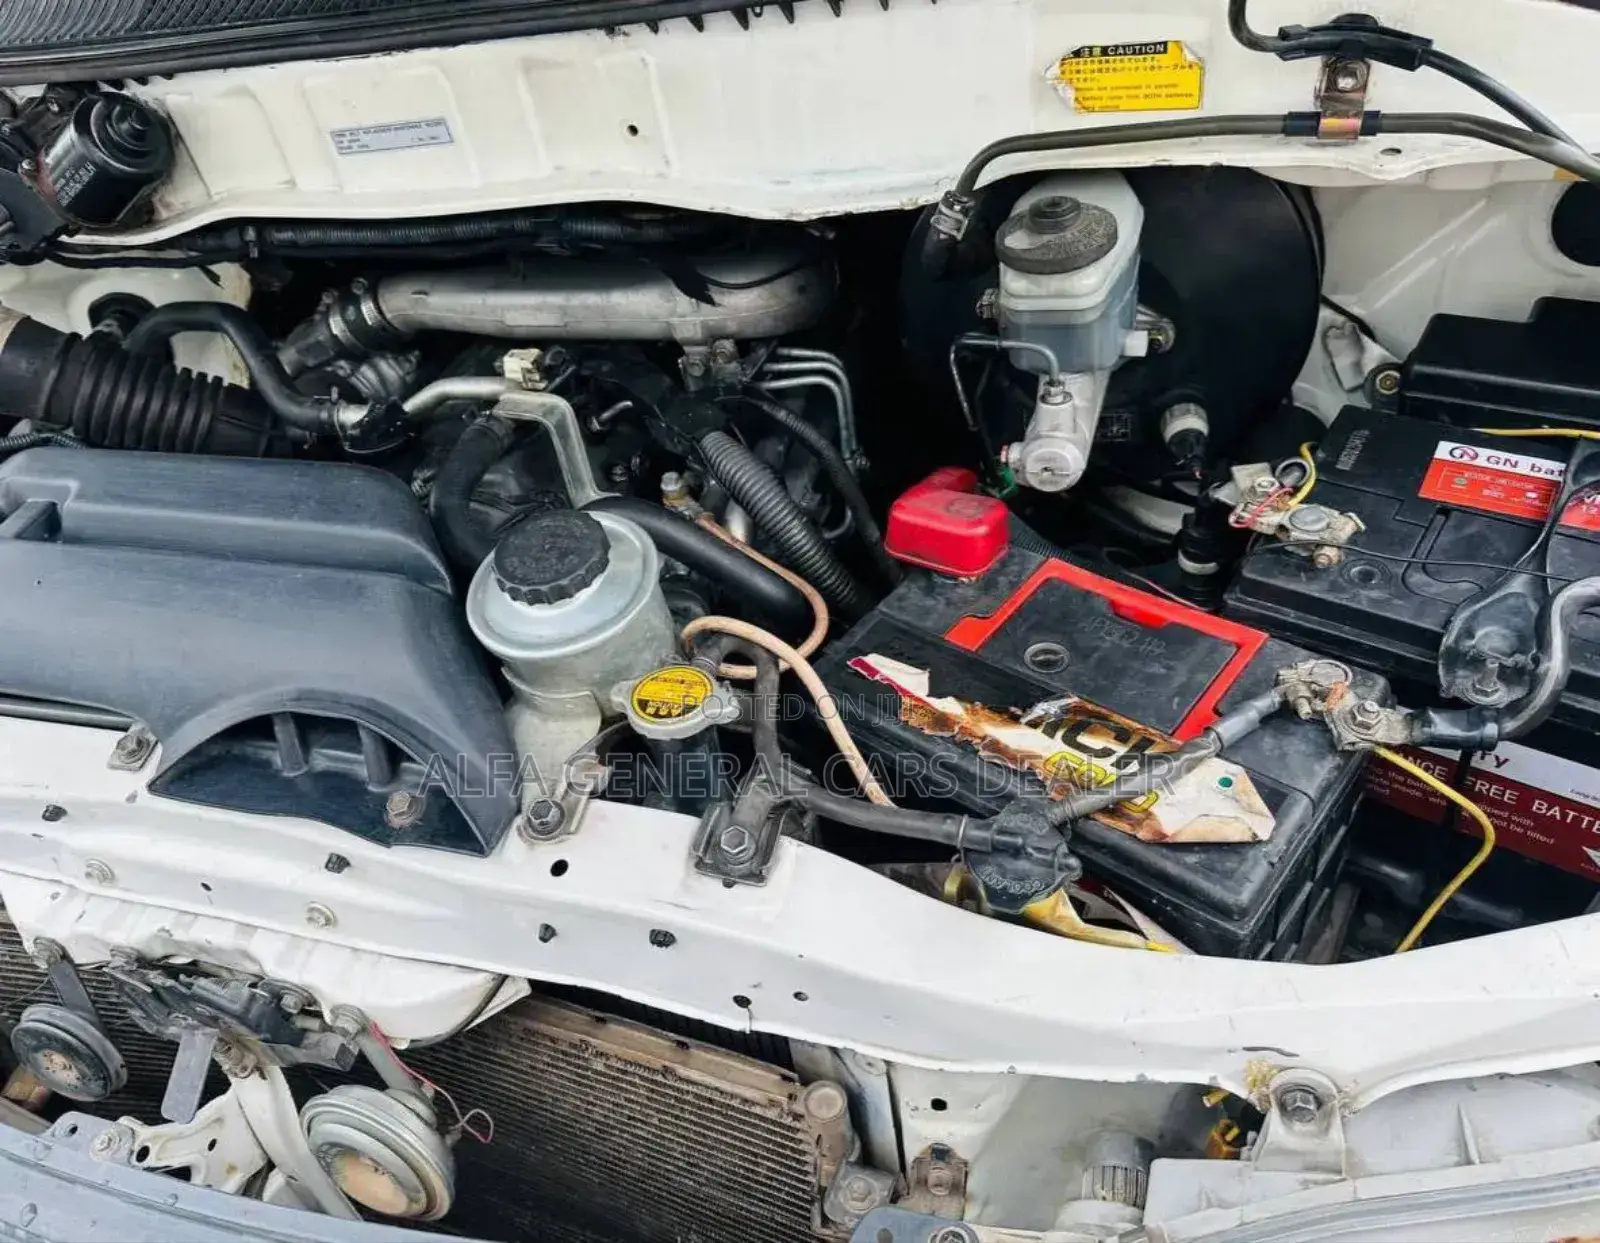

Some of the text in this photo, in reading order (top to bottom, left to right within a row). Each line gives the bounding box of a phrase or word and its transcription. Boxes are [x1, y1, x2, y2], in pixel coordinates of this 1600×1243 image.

[1107, 43, 1165, 55] CAUTION
[1486, 454, 1567, 477] GN bat
